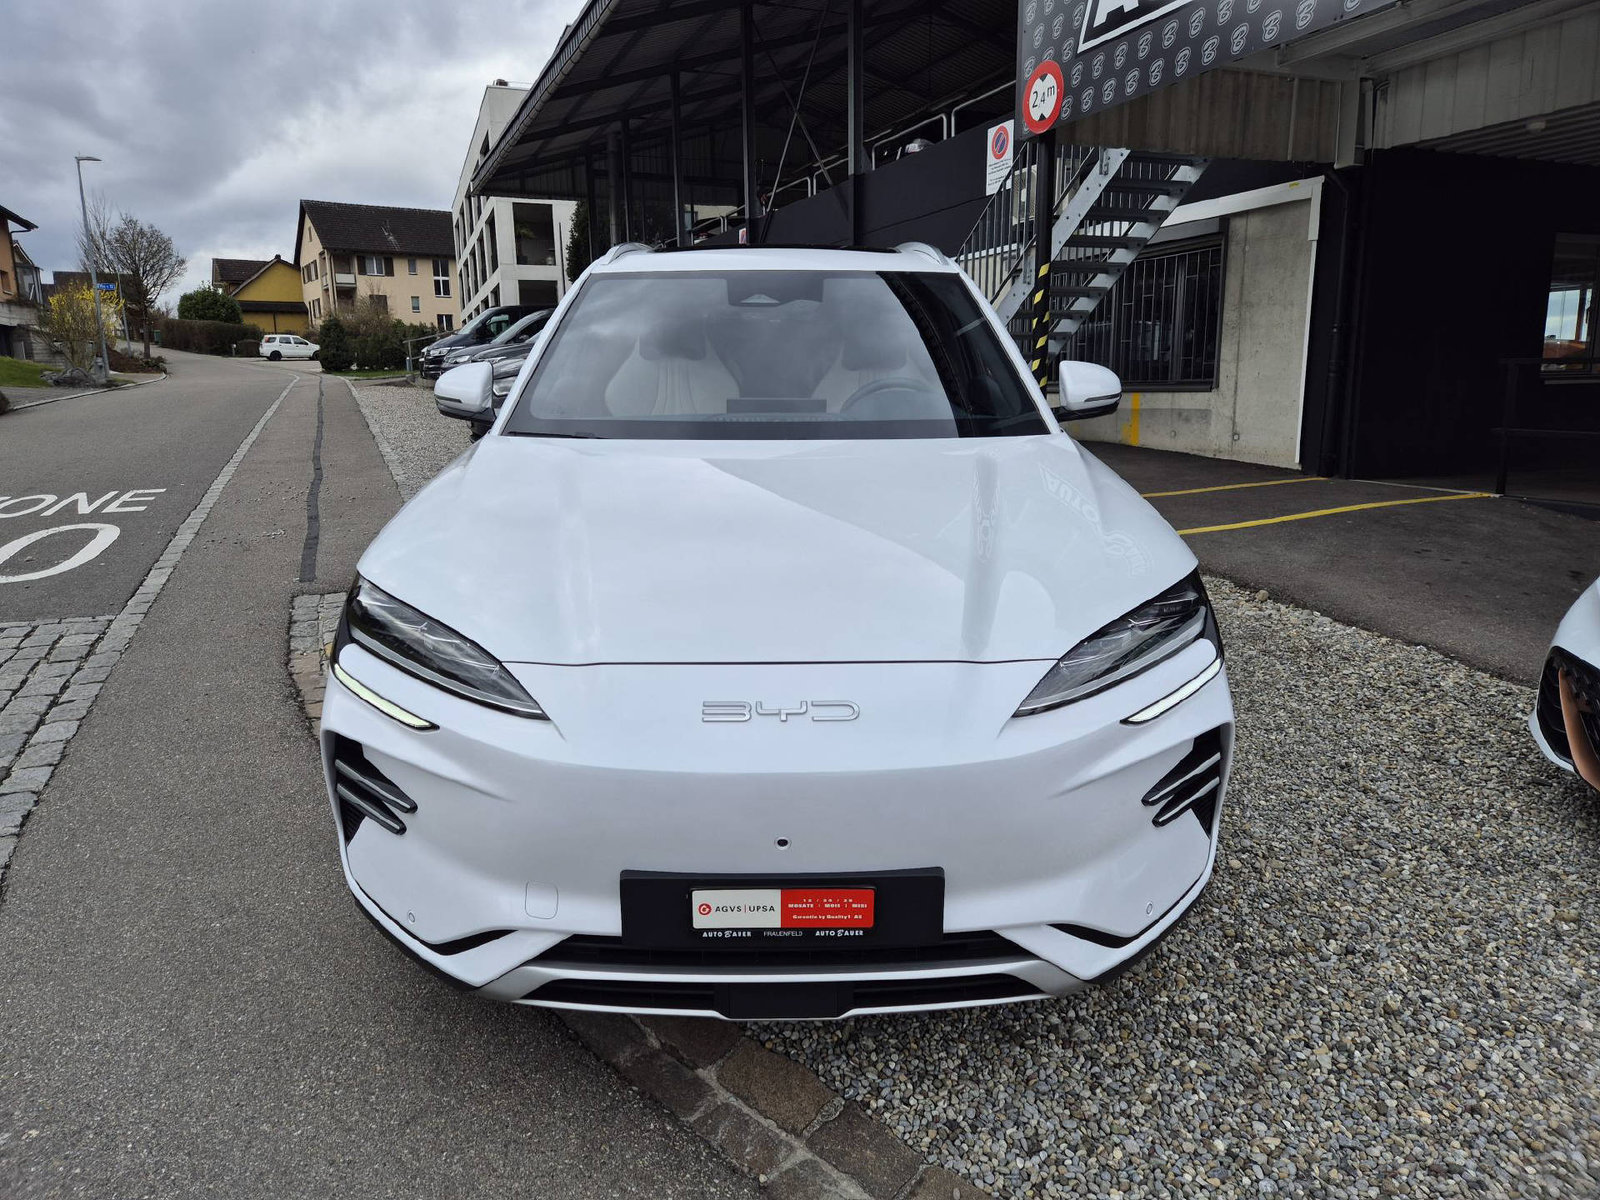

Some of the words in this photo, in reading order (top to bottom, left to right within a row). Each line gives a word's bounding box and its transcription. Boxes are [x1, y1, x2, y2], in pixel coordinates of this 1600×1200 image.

[0, 488, 167, 518] ONE
[702, 700, 860, 722] BYD
[715, 904, 742, 913] AGVS
[749, 904, 775, 912] UPSA
